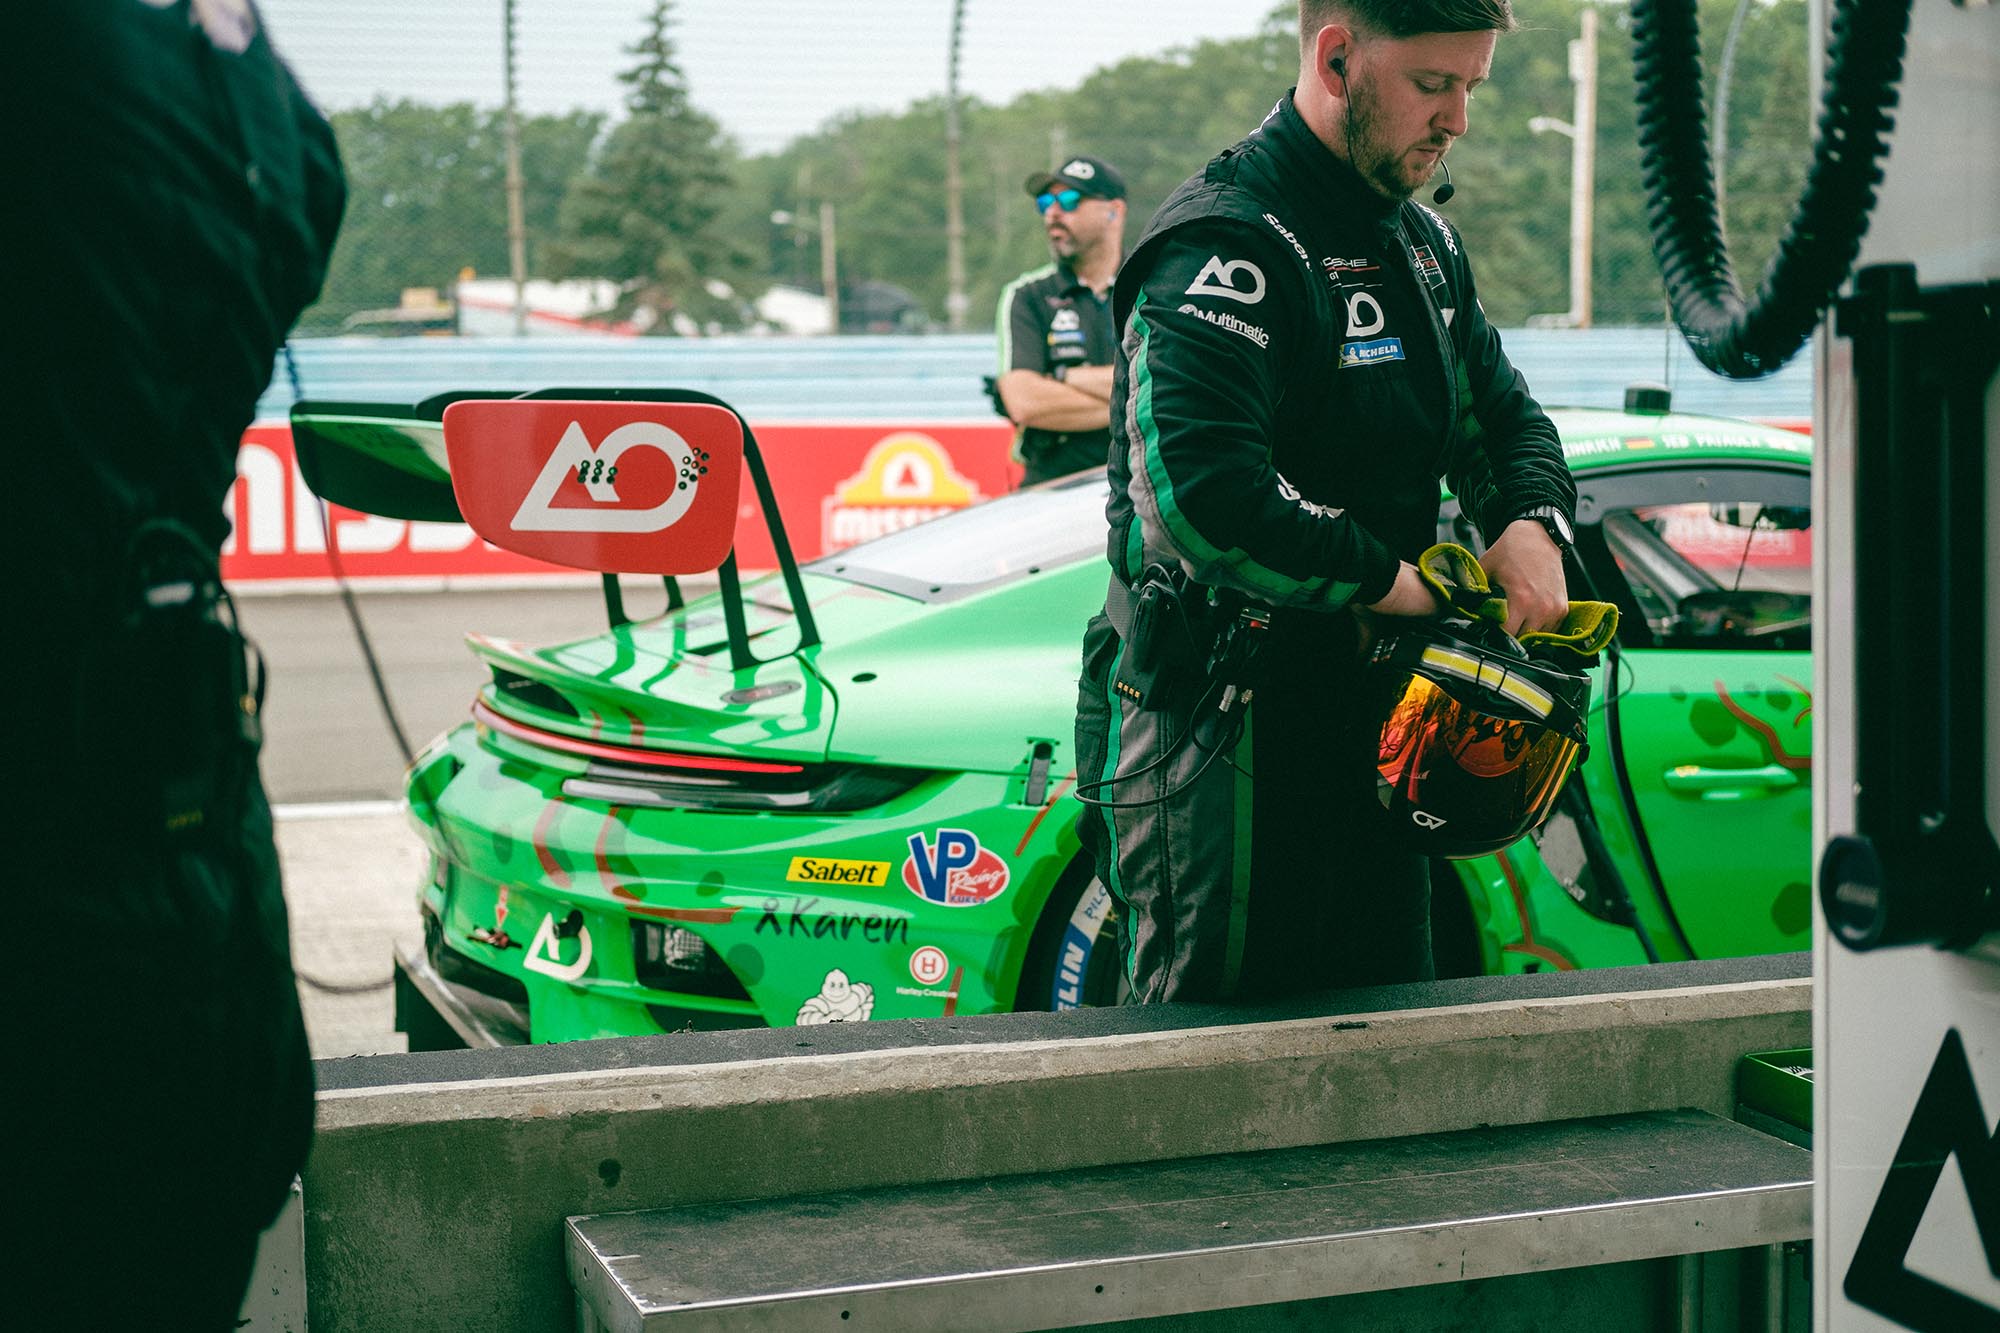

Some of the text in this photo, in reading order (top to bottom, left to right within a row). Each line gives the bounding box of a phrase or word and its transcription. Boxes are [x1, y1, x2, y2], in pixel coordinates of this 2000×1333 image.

[1197, 310, 1270, 347] Multimatic
[798, 860, 879, 884] Sabelt
[951, 868, 1007, 895] Racing
[788, 897, 909, 946] Karen
